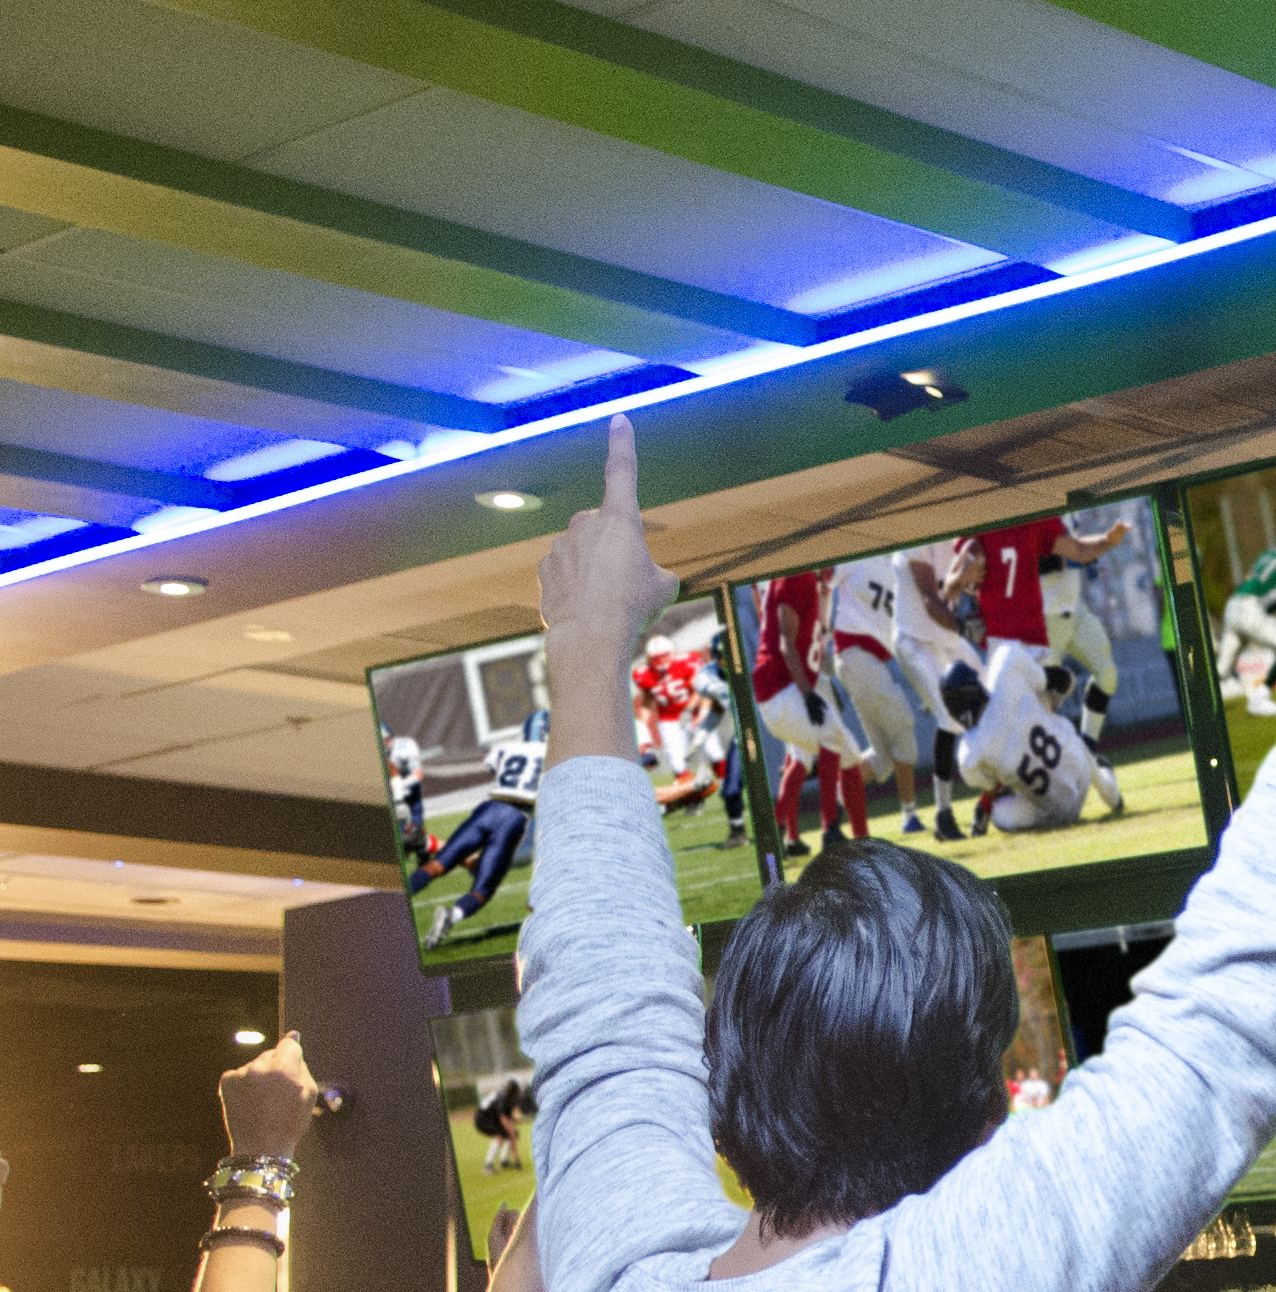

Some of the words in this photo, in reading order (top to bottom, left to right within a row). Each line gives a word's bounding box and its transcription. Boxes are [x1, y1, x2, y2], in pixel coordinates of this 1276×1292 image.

[1001, 547, 1017, 598] 7
[499, 754, 544, 791] 21
[1017, 724, 1061, 796] 58
